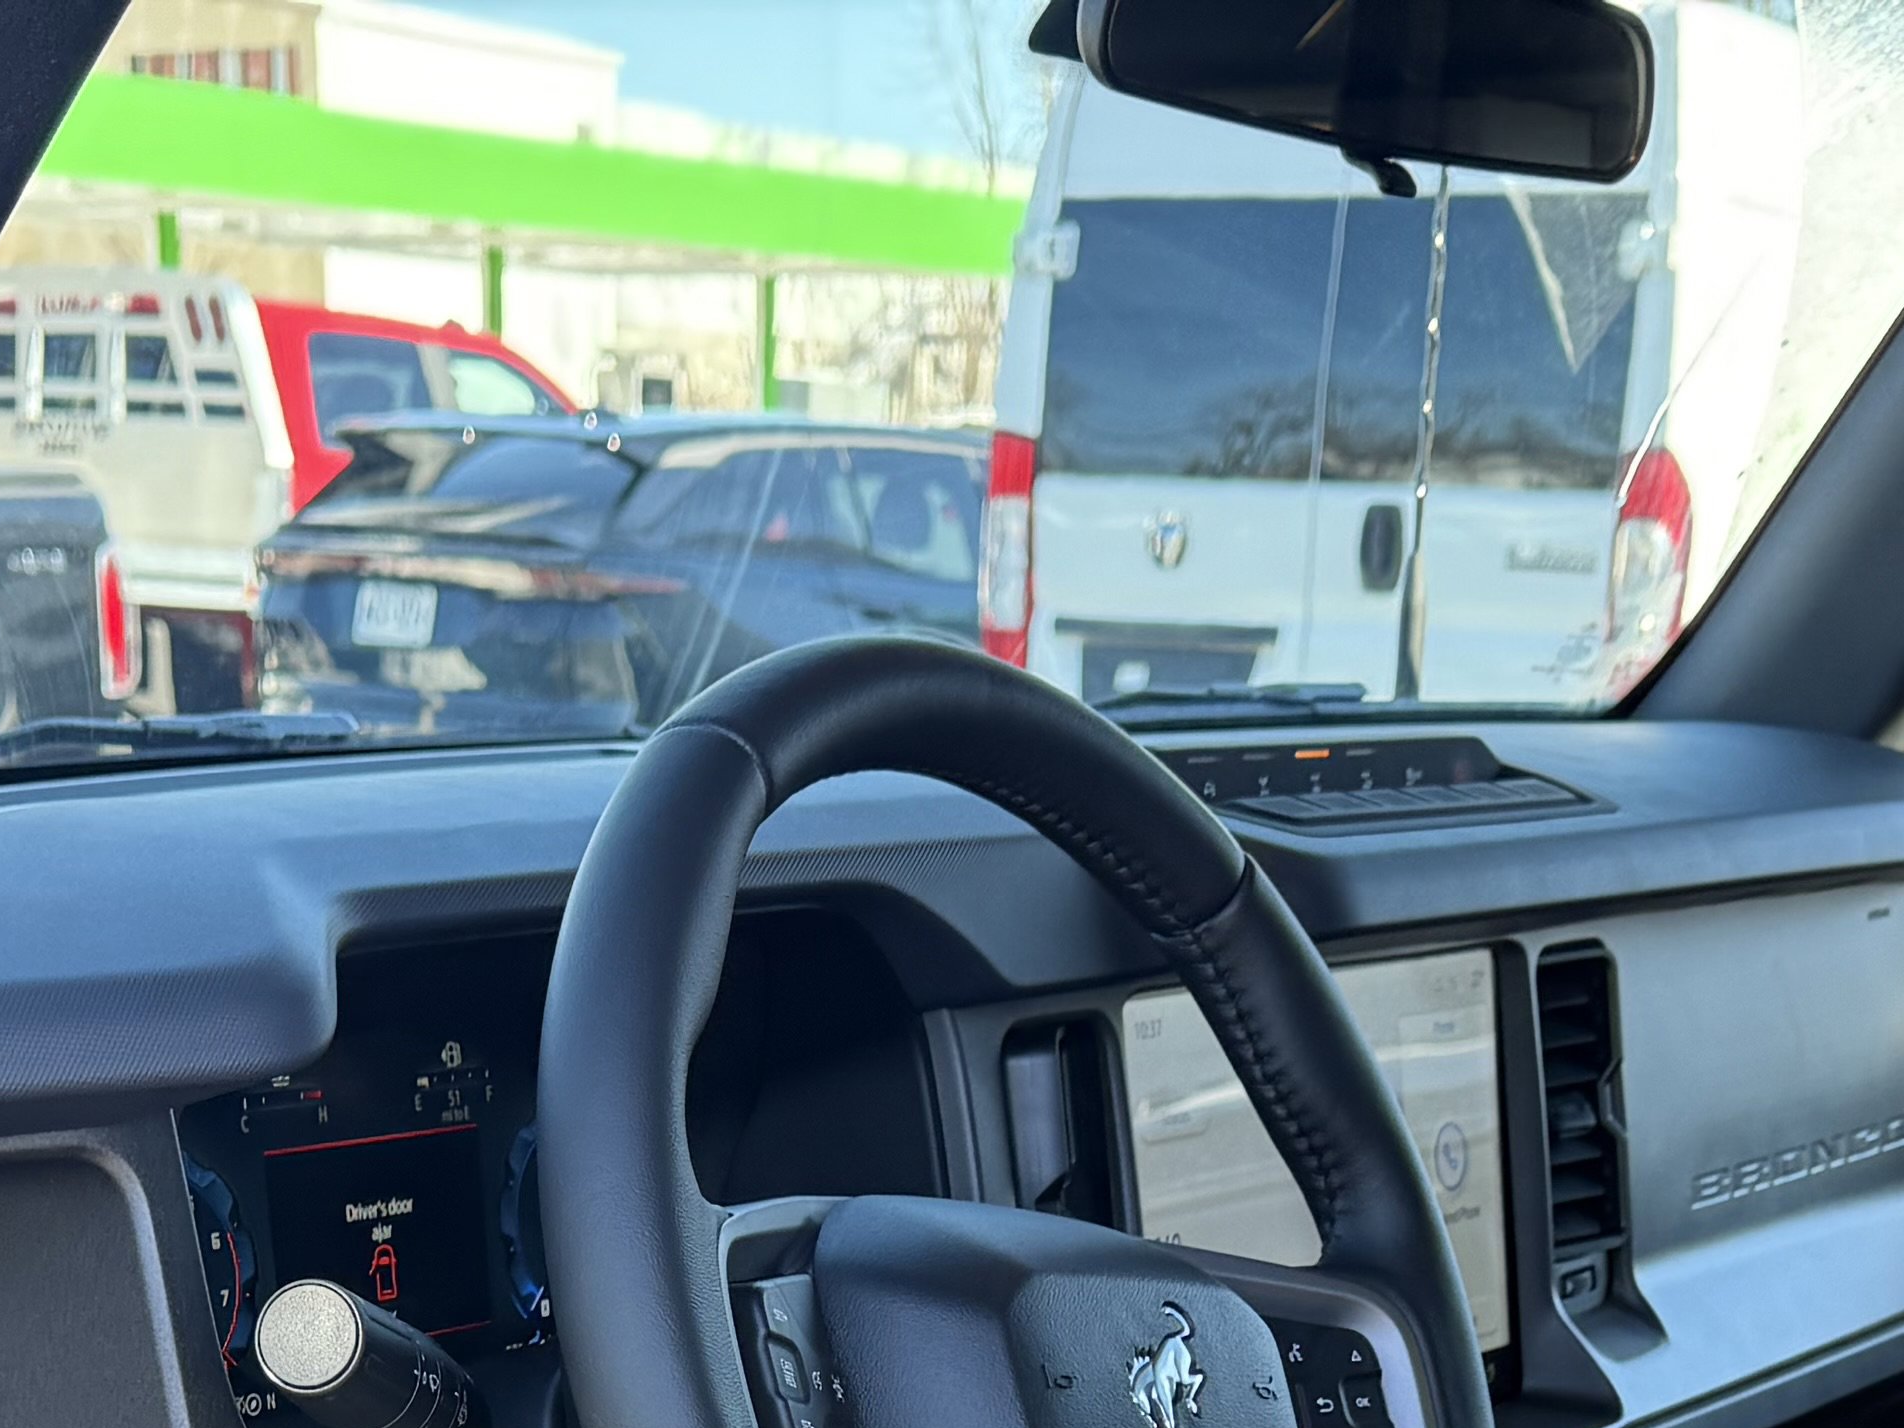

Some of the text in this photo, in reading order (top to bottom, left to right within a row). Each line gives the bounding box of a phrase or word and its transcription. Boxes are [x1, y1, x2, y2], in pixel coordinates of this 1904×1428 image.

[345, 1196, 414, 1223] Driver's door
[371, 1222, 393, 1244] ajar
[220, 1289, 230, 1309] 7
